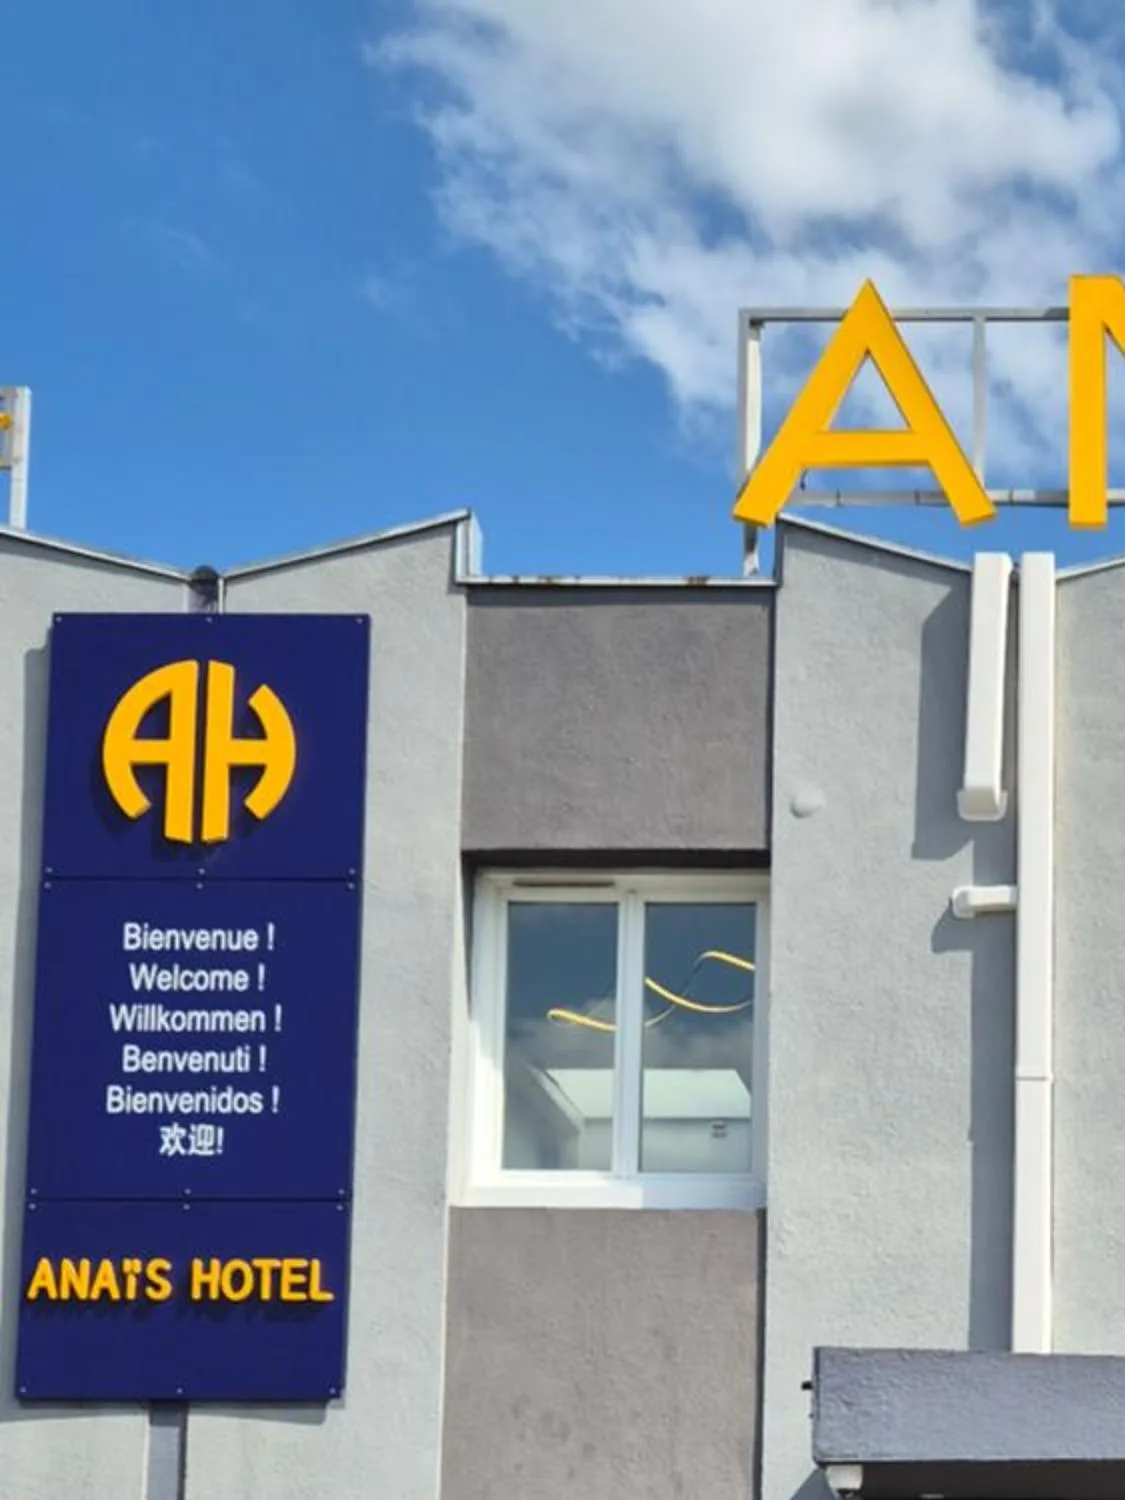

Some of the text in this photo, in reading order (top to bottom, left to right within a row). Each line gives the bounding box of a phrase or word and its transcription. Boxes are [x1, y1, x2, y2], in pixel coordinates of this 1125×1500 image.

[123, 922, 260, 951] Bienvenue
[129, 963, 250, 992] Welcome
[109, 1003, 267, 1033] Willkommen
[122, 1044, 251, 1073] Benvenuti
[105, 1084, 264, 1115] Bienvenidos
[191, 1258, 335, 1301] HOTEL
